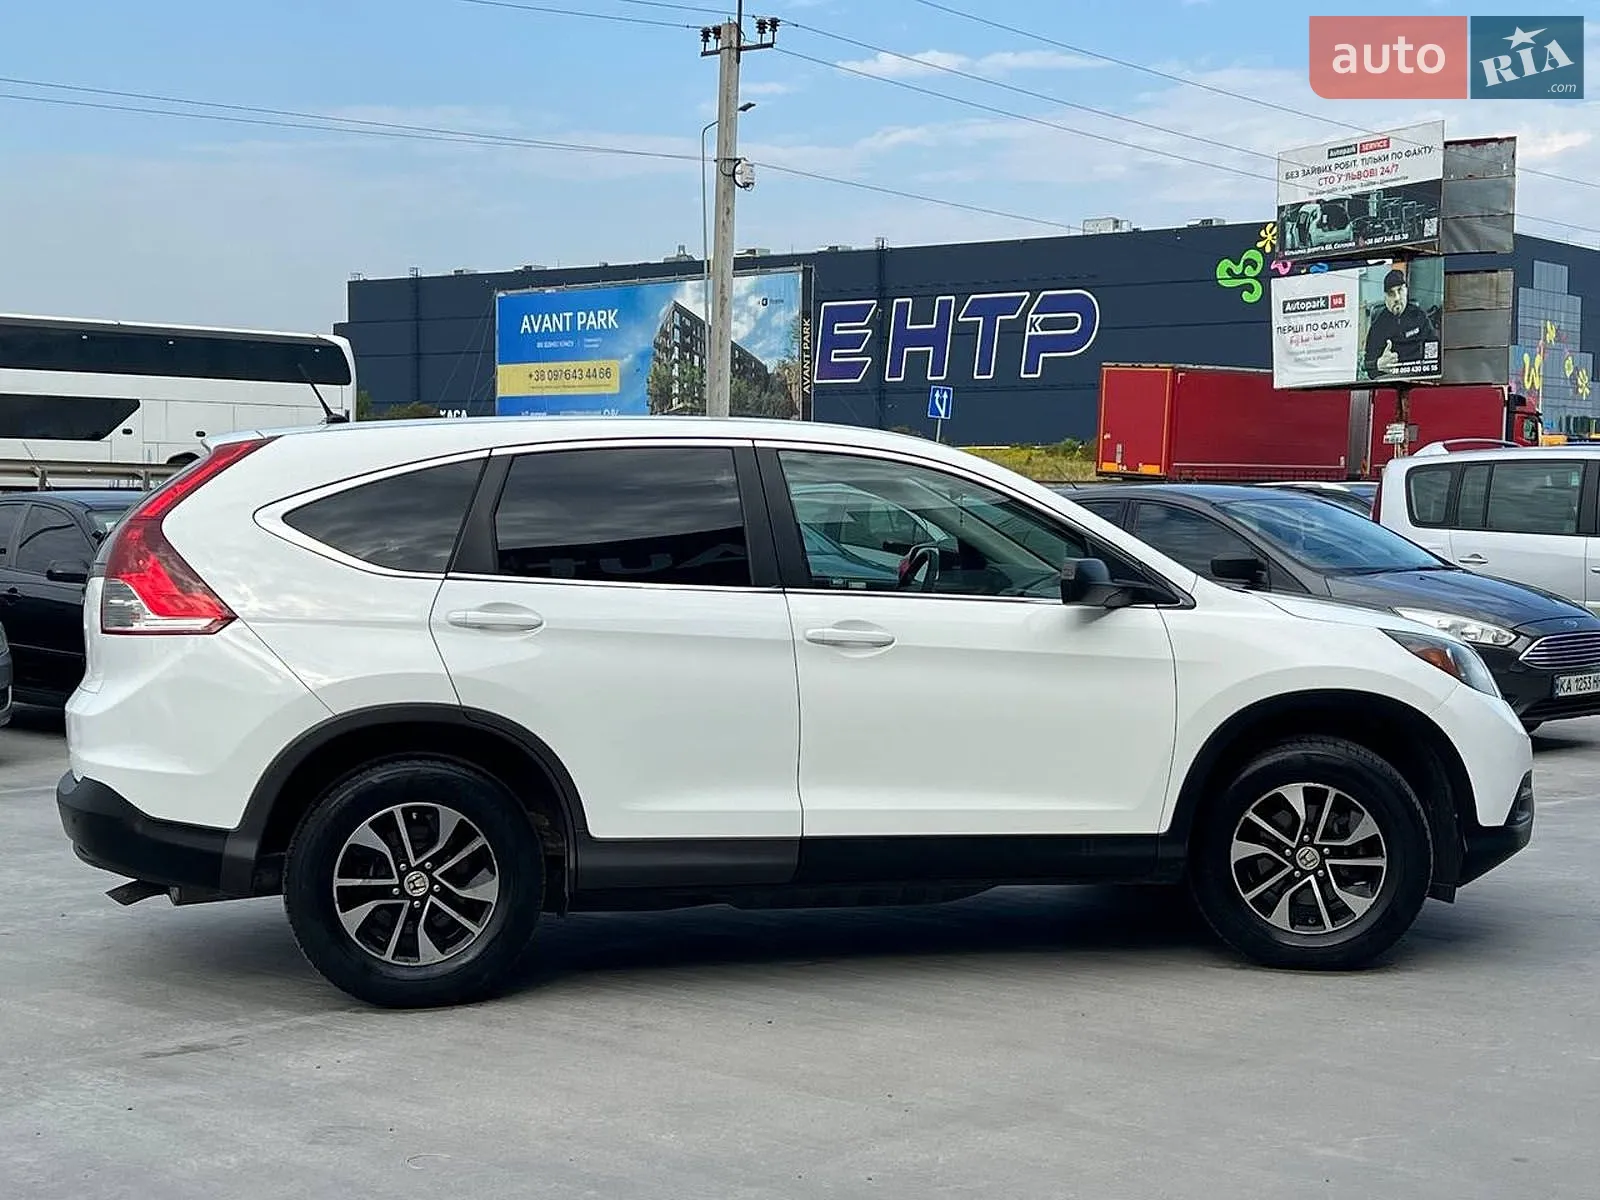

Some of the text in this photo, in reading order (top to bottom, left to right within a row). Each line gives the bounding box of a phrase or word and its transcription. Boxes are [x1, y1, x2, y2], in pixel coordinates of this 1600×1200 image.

[1285, 170, 1300, 180] БЕЗ
[1301, 163, 1332, 177] ЗАЙВИХ
[1391, 151, 1403, 160] ПО
[1318, 175, 1335, 186] СТО
[1345, 168, 1378, 181] ЛЬВОВІ
[1379, 163, 1399, 176] 24/7
[1284, 297, 1326, 312] Autopark
[520, 308, 619, 334] AVANT PARK
[1276, 324, 1304, 335] ПЕРШІ
[1305, 323, 1319, 332] ПО
[803, 318, 811, 394] AVANT PARK
[528, 367, 612, 381] +38 097 643 44 66
